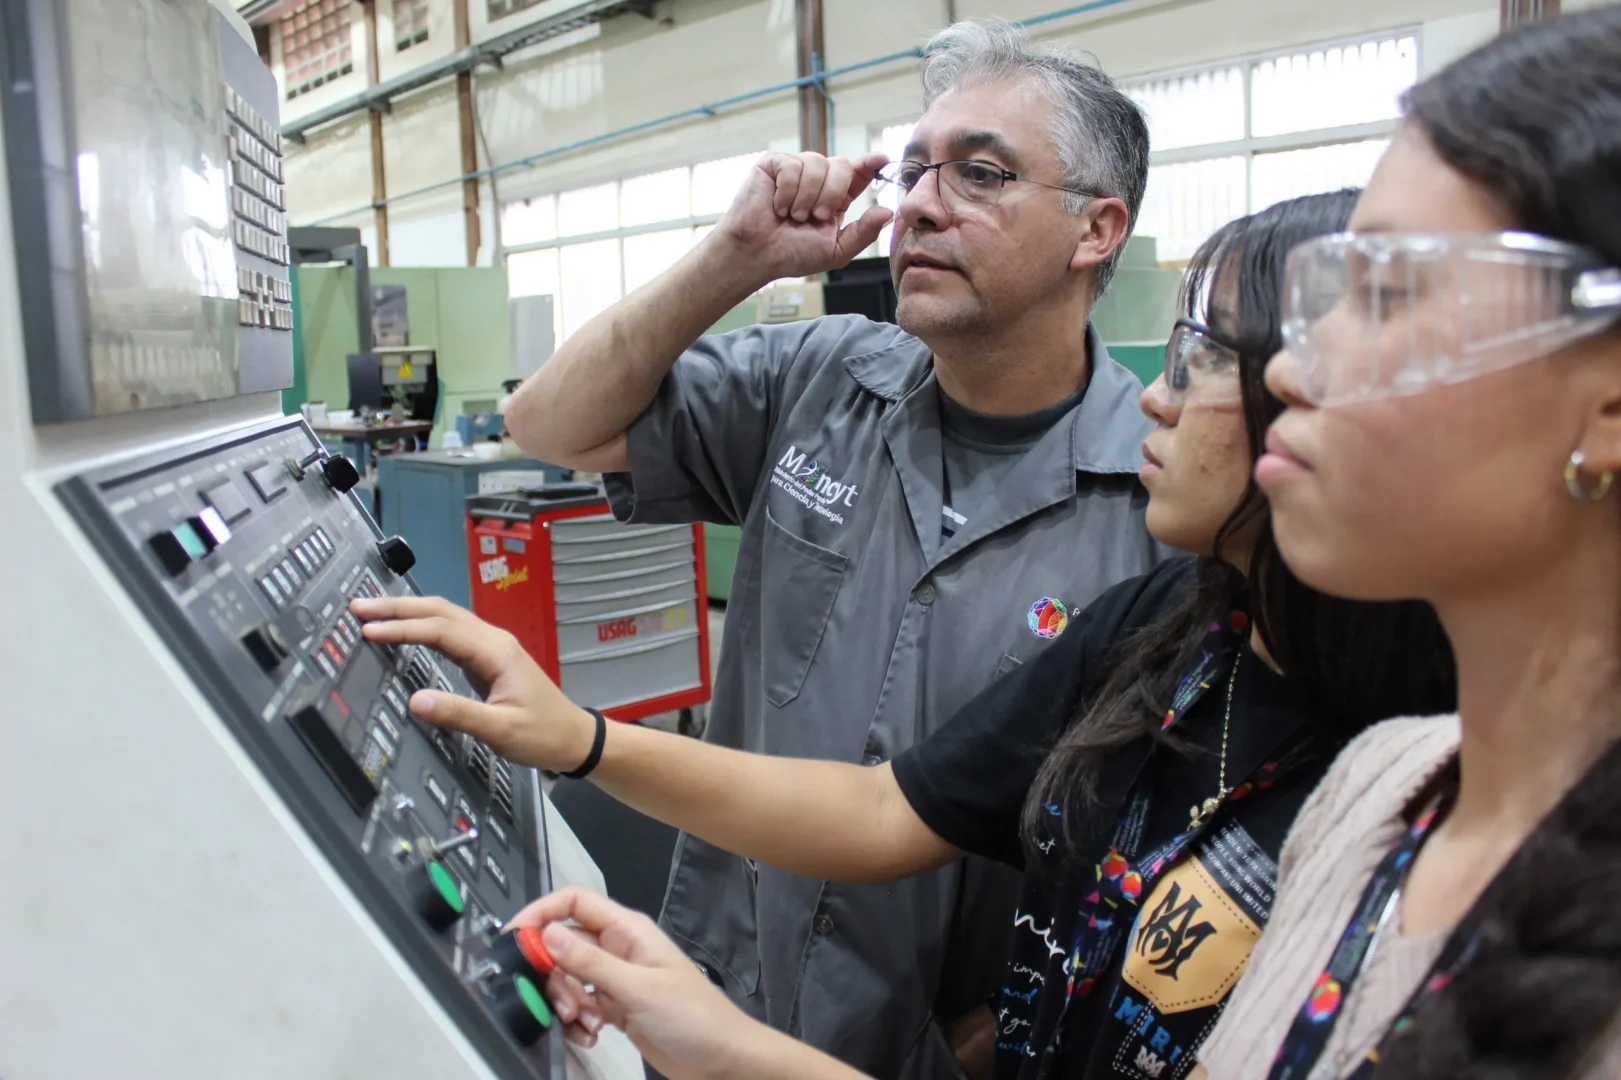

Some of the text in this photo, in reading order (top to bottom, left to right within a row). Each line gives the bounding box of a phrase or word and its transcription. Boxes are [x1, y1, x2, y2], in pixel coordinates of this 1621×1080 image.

[783, 481, 811, 505] Ciencia
[597, 616, 638, 642] USAG
[1206, 851, 1233, 881] COMPANY
[1243, 873, 1271, 903] WORLD
